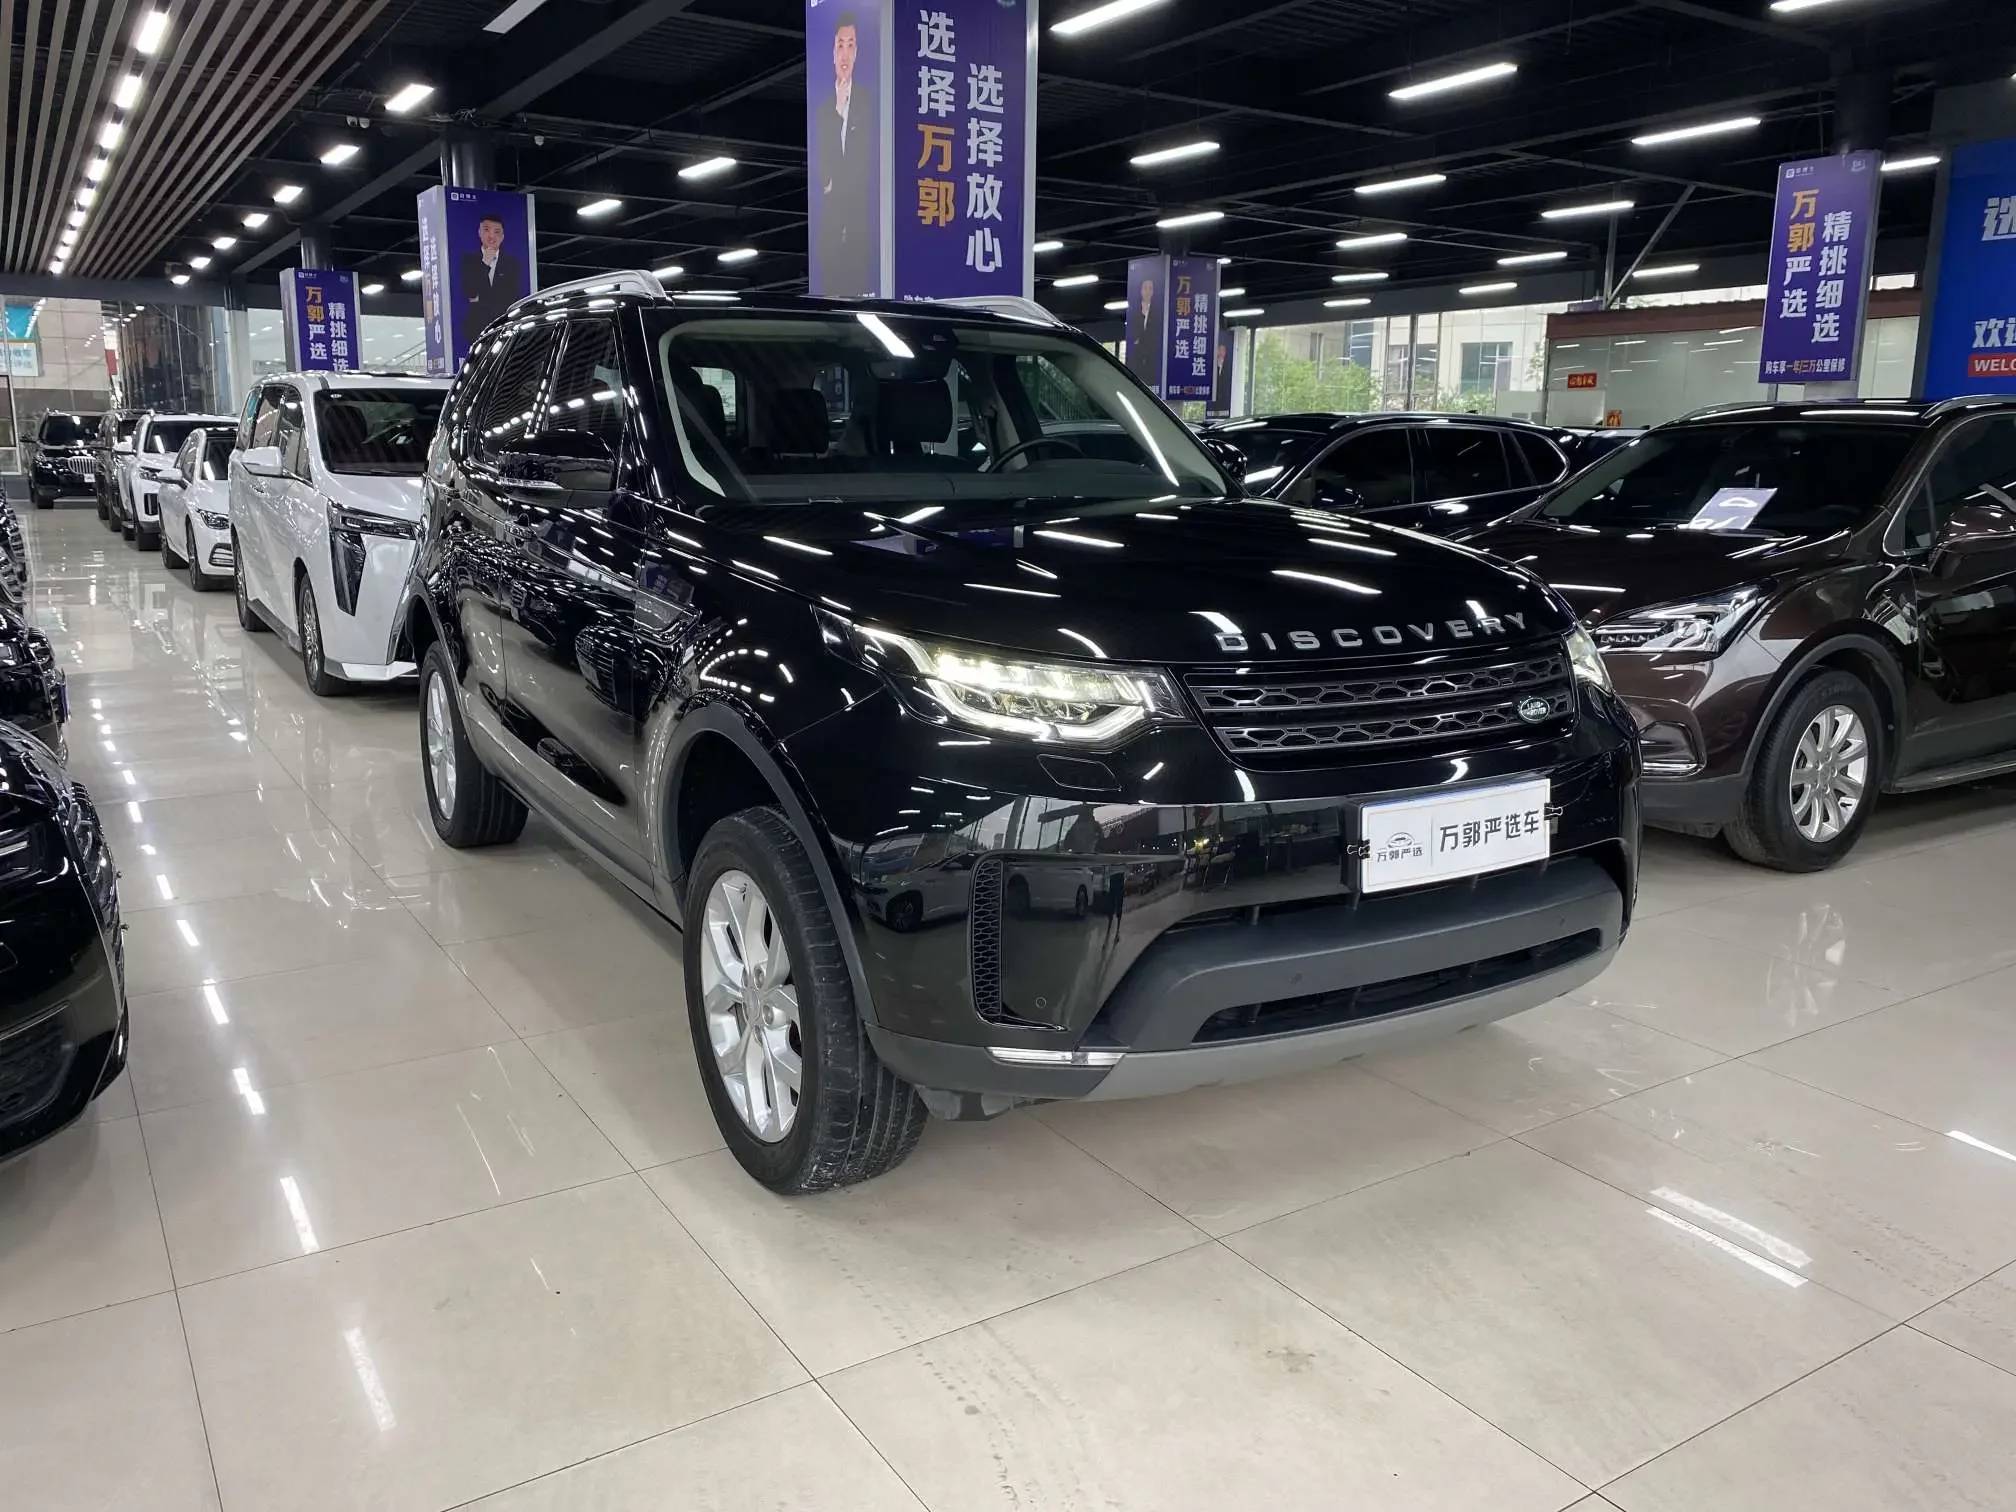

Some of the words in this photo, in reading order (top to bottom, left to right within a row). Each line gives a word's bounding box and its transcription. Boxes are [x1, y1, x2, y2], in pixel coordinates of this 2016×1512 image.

[917, 9, 956, 227] 选择万郭
[965, 63, 1004, 273] 选择放心
[1780, 189, 1819, 319] 万郭严选
[1811, 211, 1852, 343] 精挑细选
[305, 286, 327, 360] 万郭严选
[328, 302, 349, 371] 精挑细选
[1175, 276, 1192, 359] 万郭严选
[1192, 293, 1208, 376] 精挑细选
[1214, 611, 1526, 651] DISCOVERY
[1377, 846, 1423, 863] 万郭严选
[1439, 810, 1540, 853] 万郭严选车
